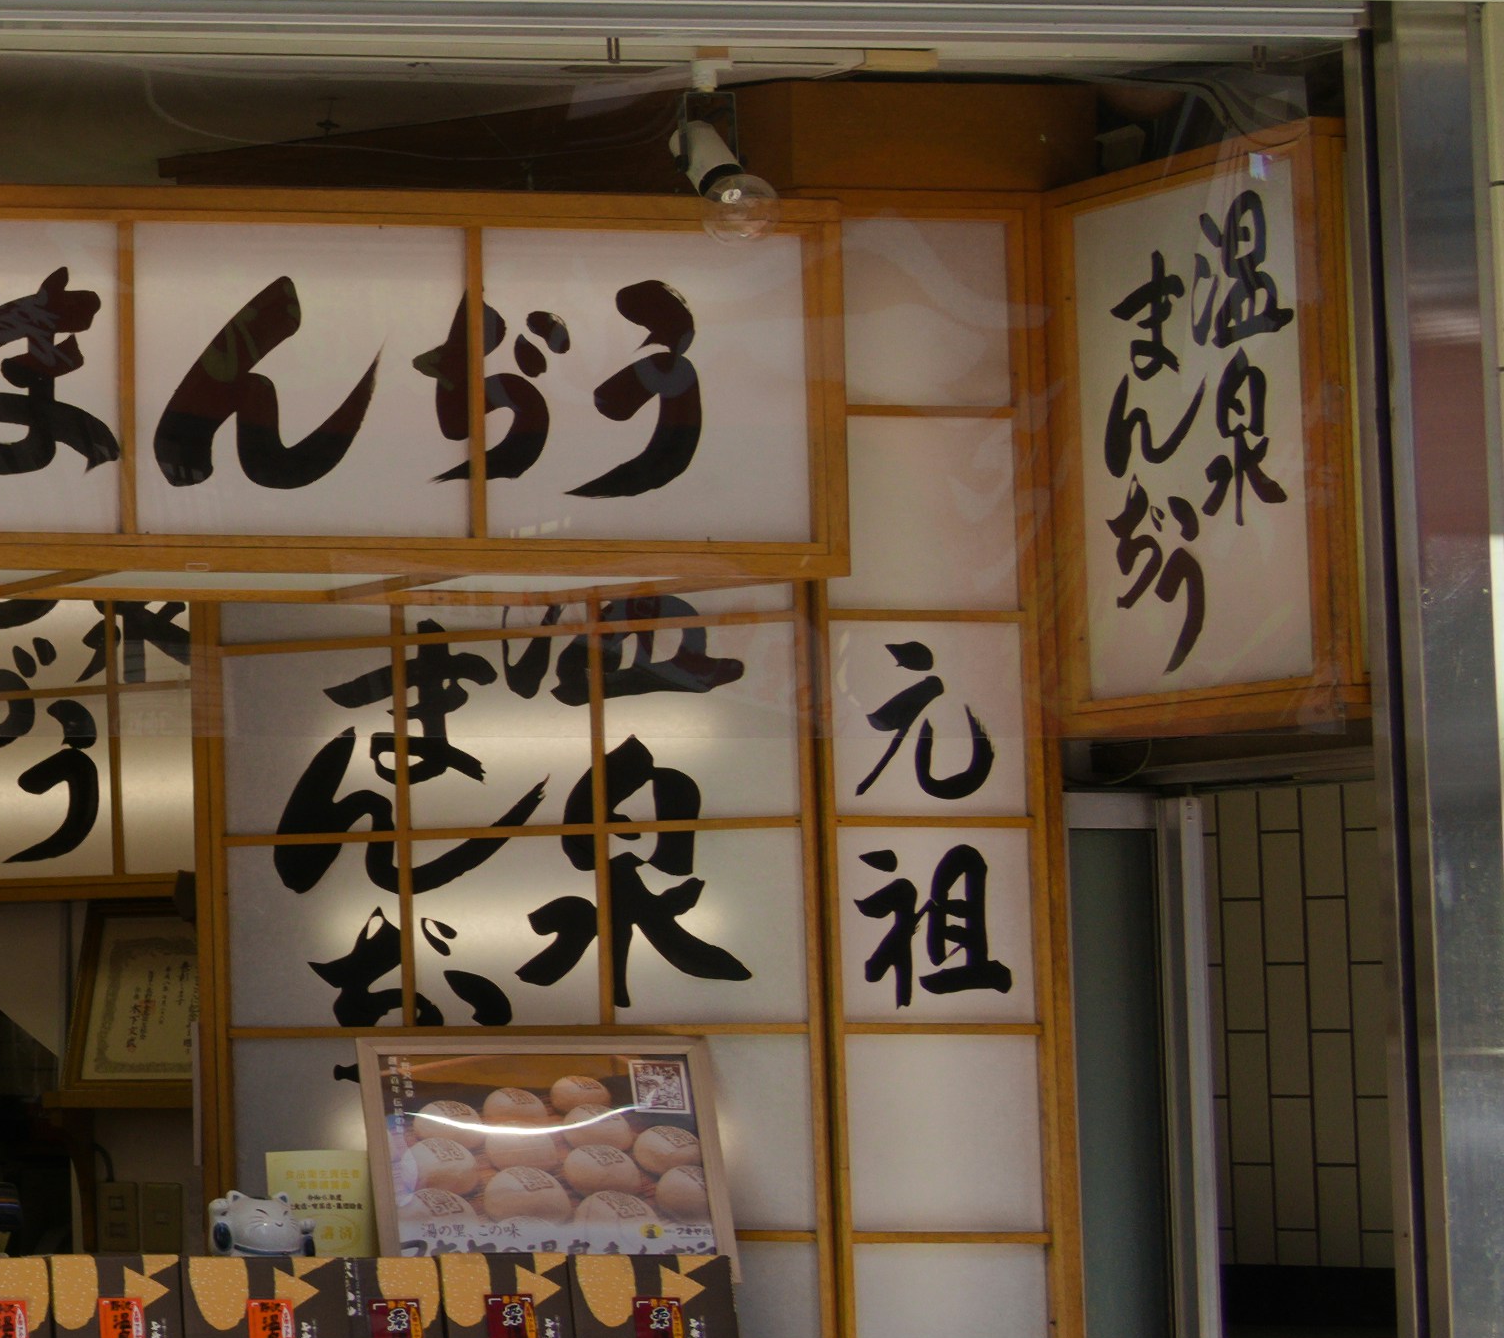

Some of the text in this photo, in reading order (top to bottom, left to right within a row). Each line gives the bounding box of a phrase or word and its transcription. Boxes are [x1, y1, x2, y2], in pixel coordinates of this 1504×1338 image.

[1103, 250, 1208, 674] まんぢう
[1190, 188, 1295, 527] 温泉
[272, 618, 550, 1082] まんぢ
[853, 640, 1012, 1009] 元祖
